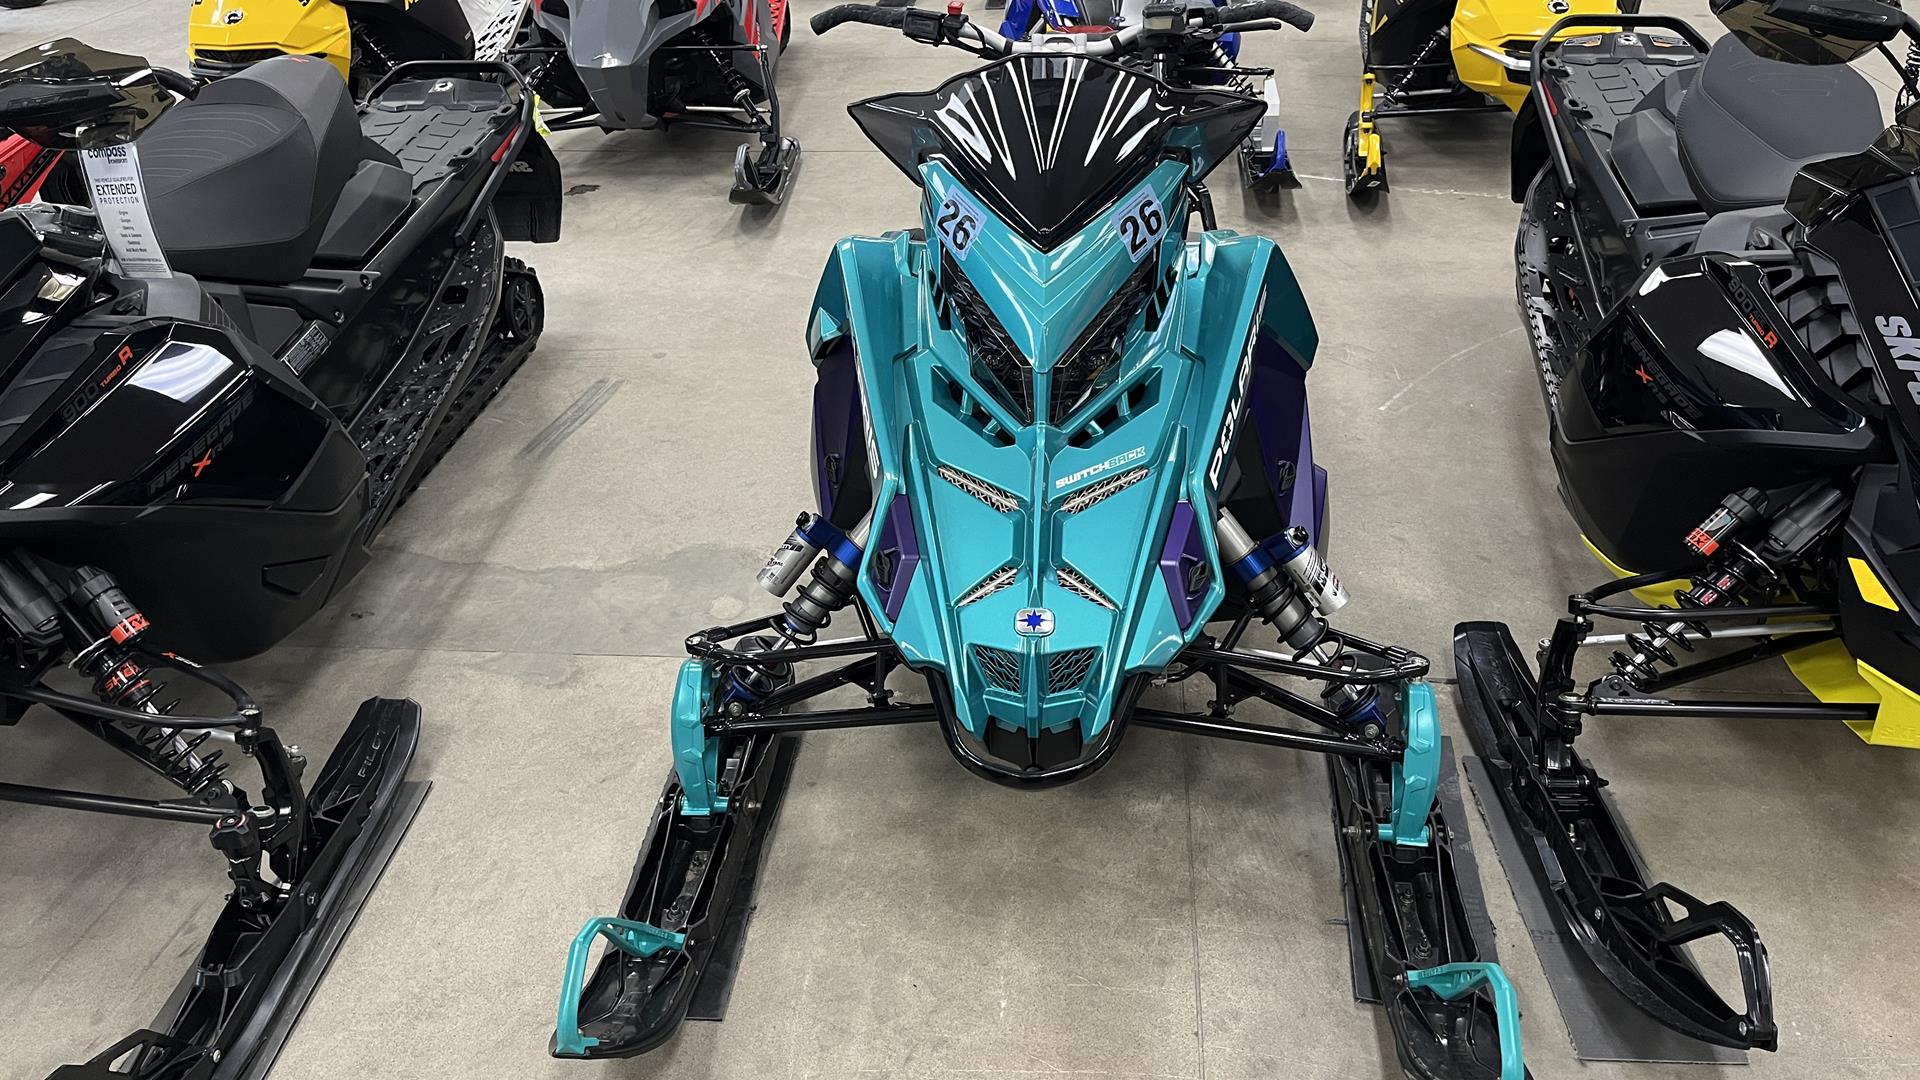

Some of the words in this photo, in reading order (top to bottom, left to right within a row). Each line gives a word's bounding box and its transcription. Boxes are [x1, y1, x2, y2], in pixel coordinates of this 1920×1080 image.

[88, 146, 126, 164] compass
[96, 183, 137, 196] EXTENDED
[100, 196, 140, 205] PROTECTION
[937, 199, 976, 251] 26
[1120, 199, 1162, 254] 26
[1728, 278, 1753, 314] 900
[1764, 331, 1778, 349] R
[62, 382, 98, 422] 900
[100, 364, 121, 388] TURBO
[118, 345, 133, 366] R
[1209, 283, 1267, 491] POLARIS
[1055, 446, 1146, 489] SWITCHBACK
